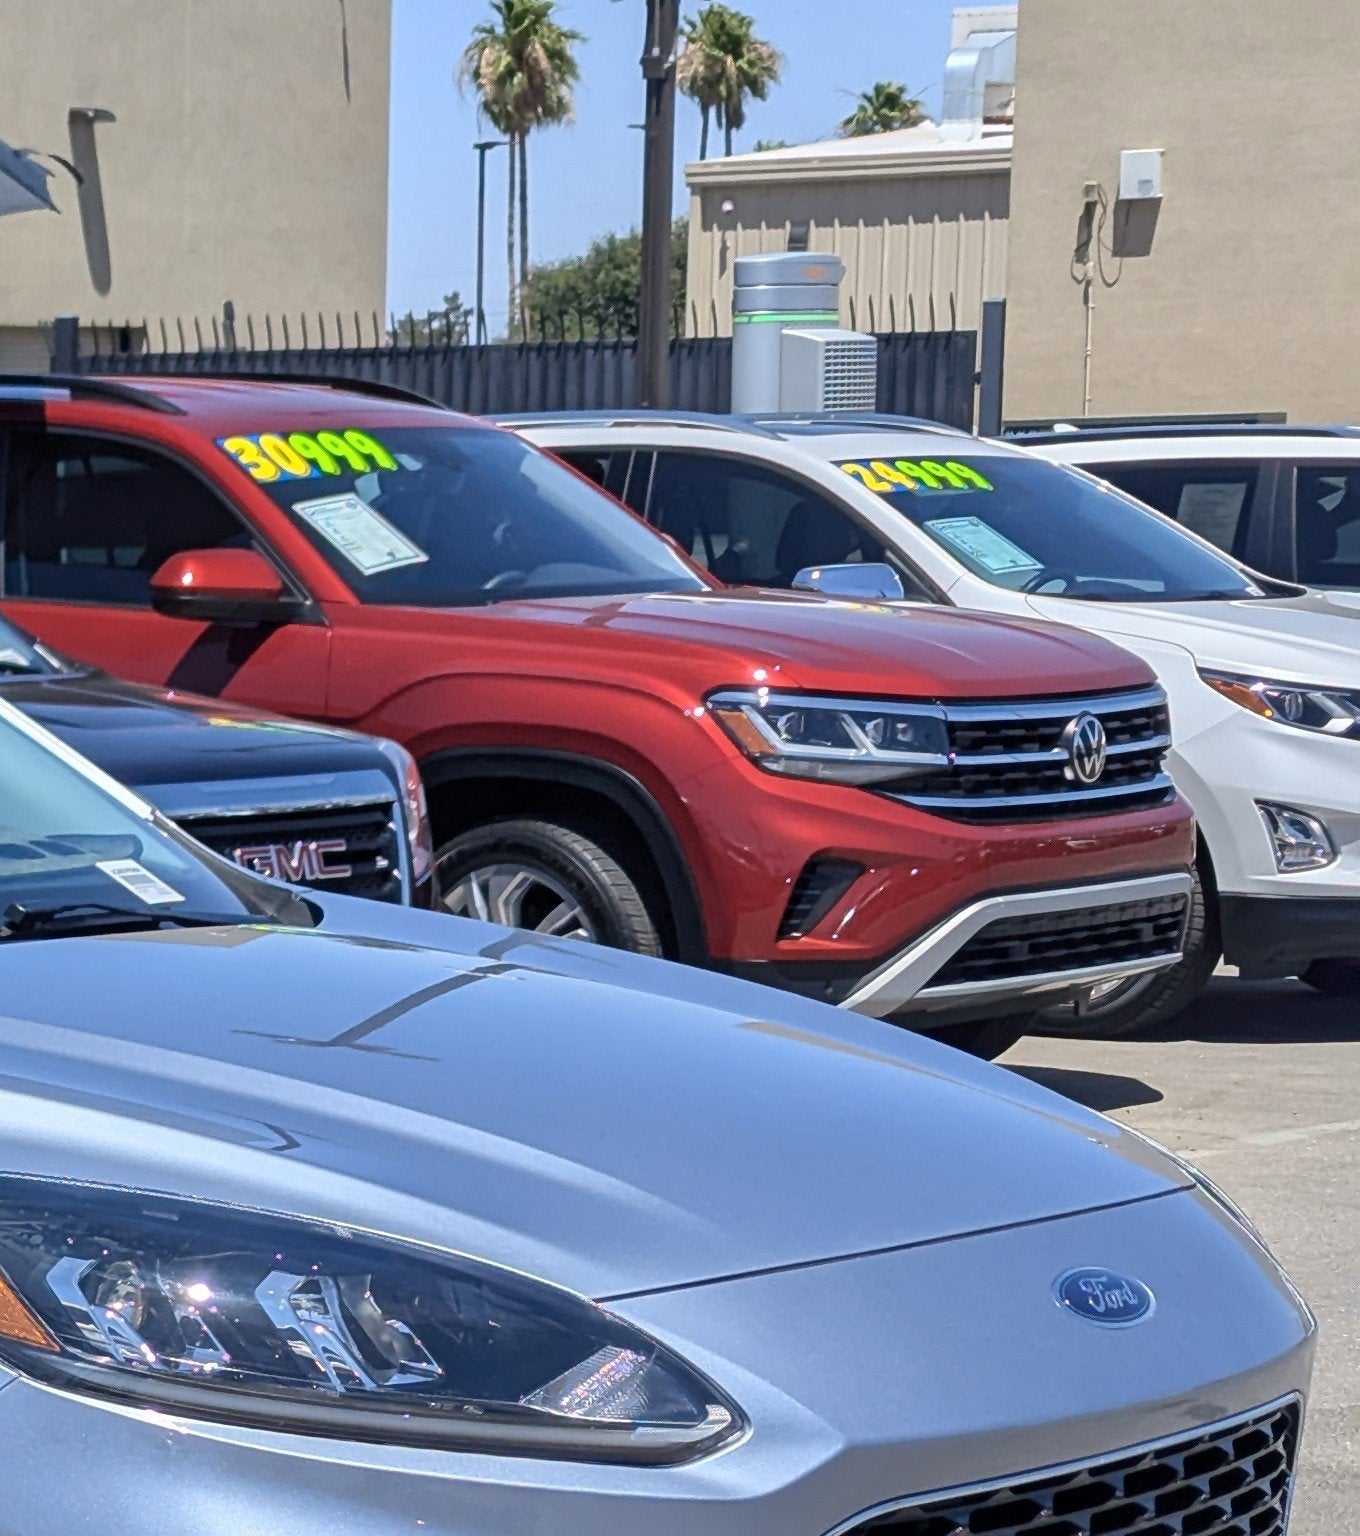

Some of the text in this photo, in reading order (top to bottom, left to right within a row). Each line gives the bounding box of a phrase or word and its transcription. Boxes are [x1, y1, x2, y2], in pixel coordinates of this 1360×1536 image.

[223, 428, 398, 482] 30999
[840, 460, 994, 493] 24999
[233, 840, 353, 882] GMC
[1078, 1275, 1139, 1313] Ford
